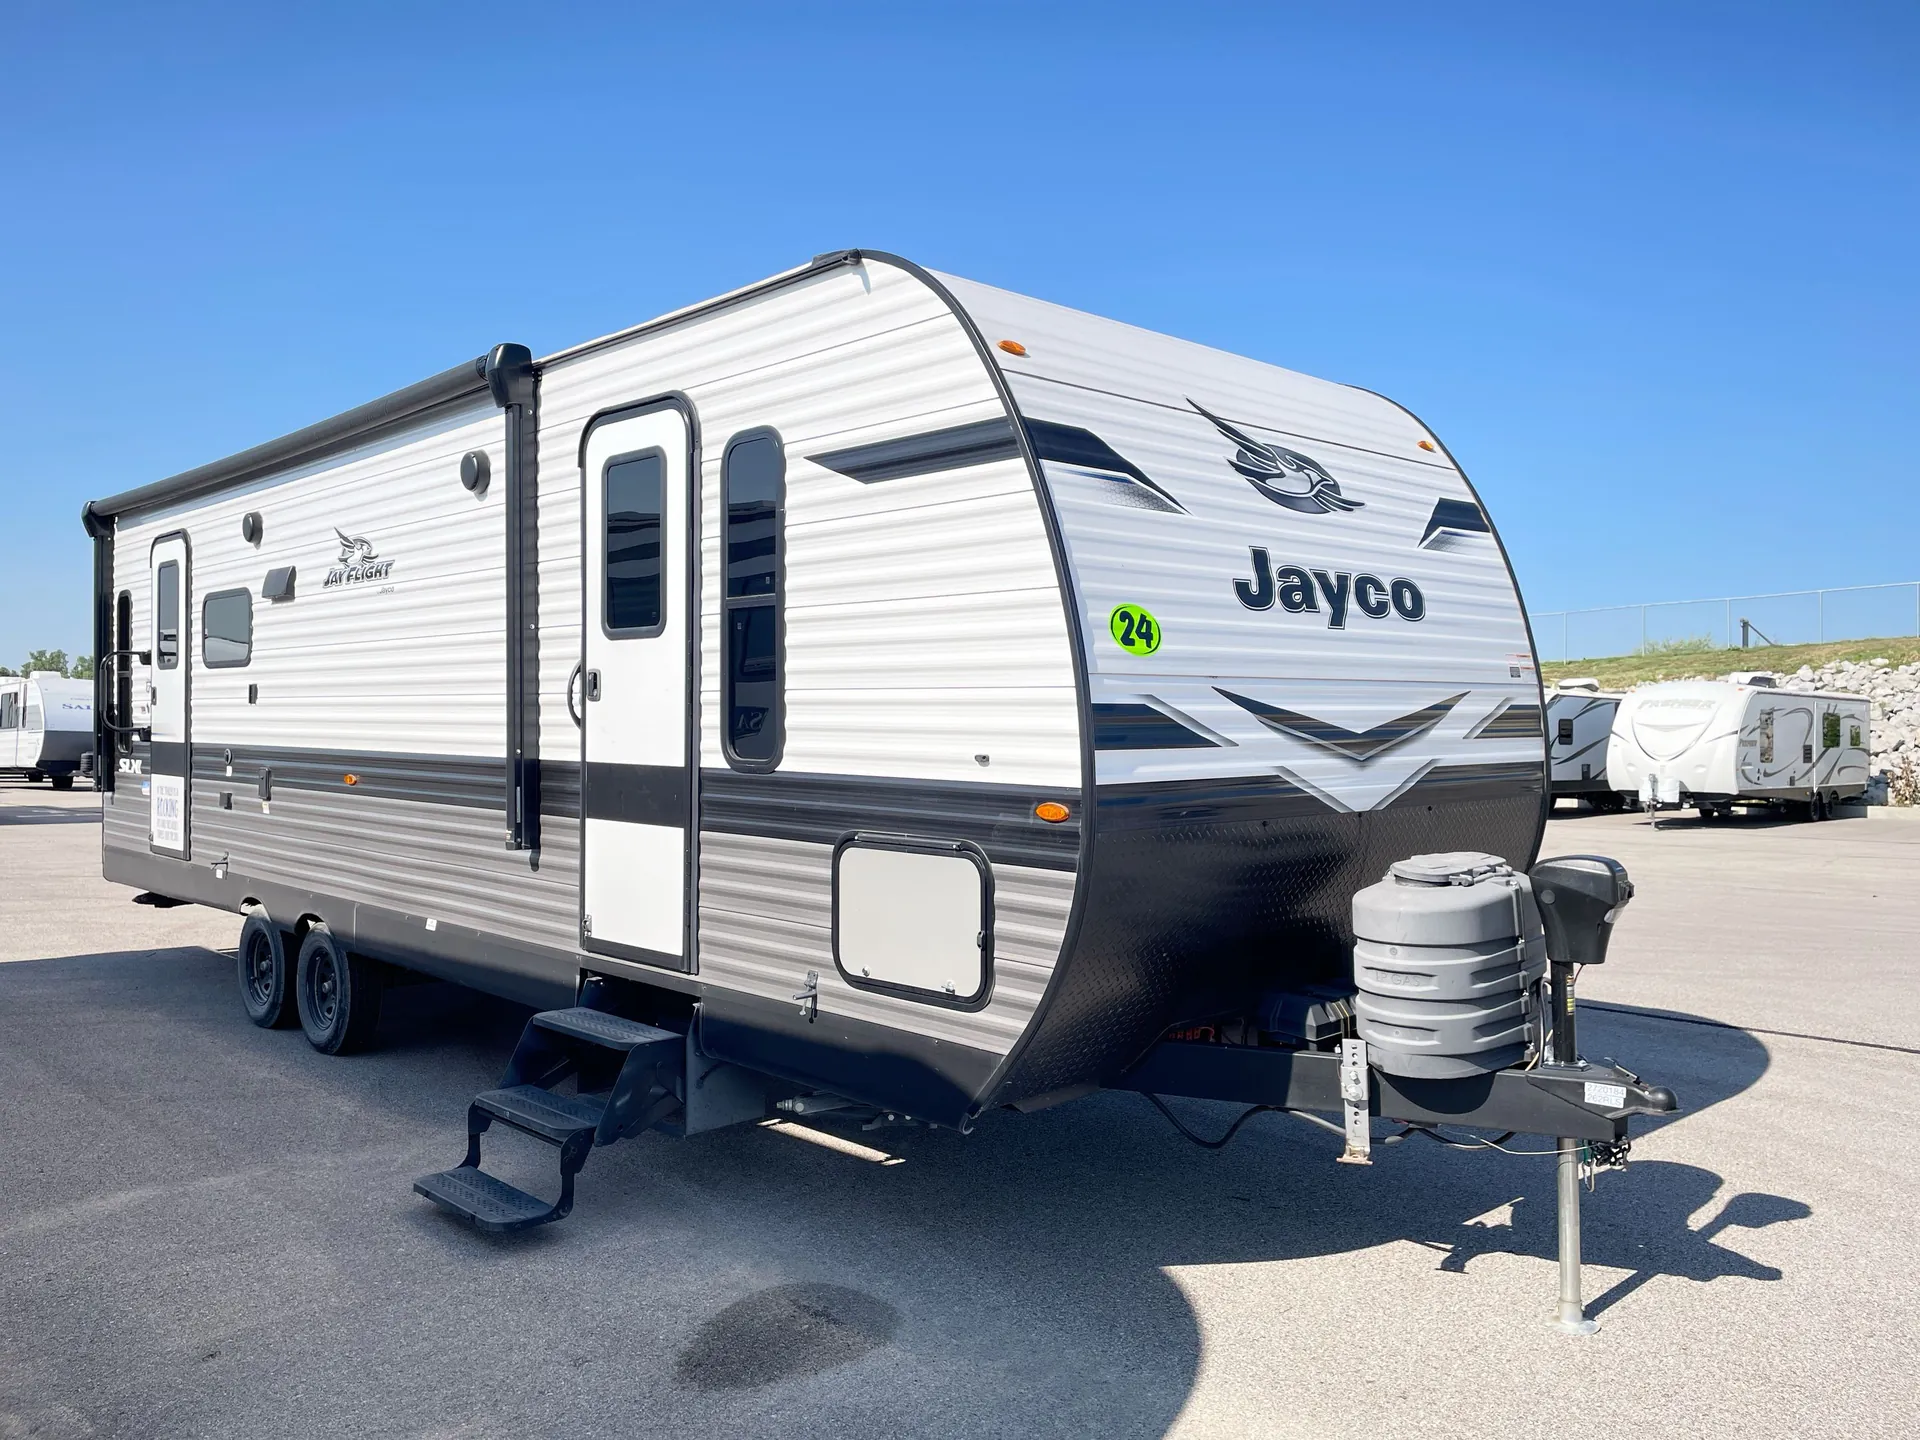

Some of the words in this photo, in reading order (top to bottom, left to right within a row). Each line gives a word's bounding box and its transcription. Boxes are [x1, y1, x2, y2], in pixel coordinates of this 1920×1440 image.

[322, 566, 346, 589] JAY
[345, 559, 396, 585] FLIGHT
[1233, 546, 1426, 630] Jayco
[1119, 610, 1154, 649] 24
[1391, 973, 1421, 987] GAS
